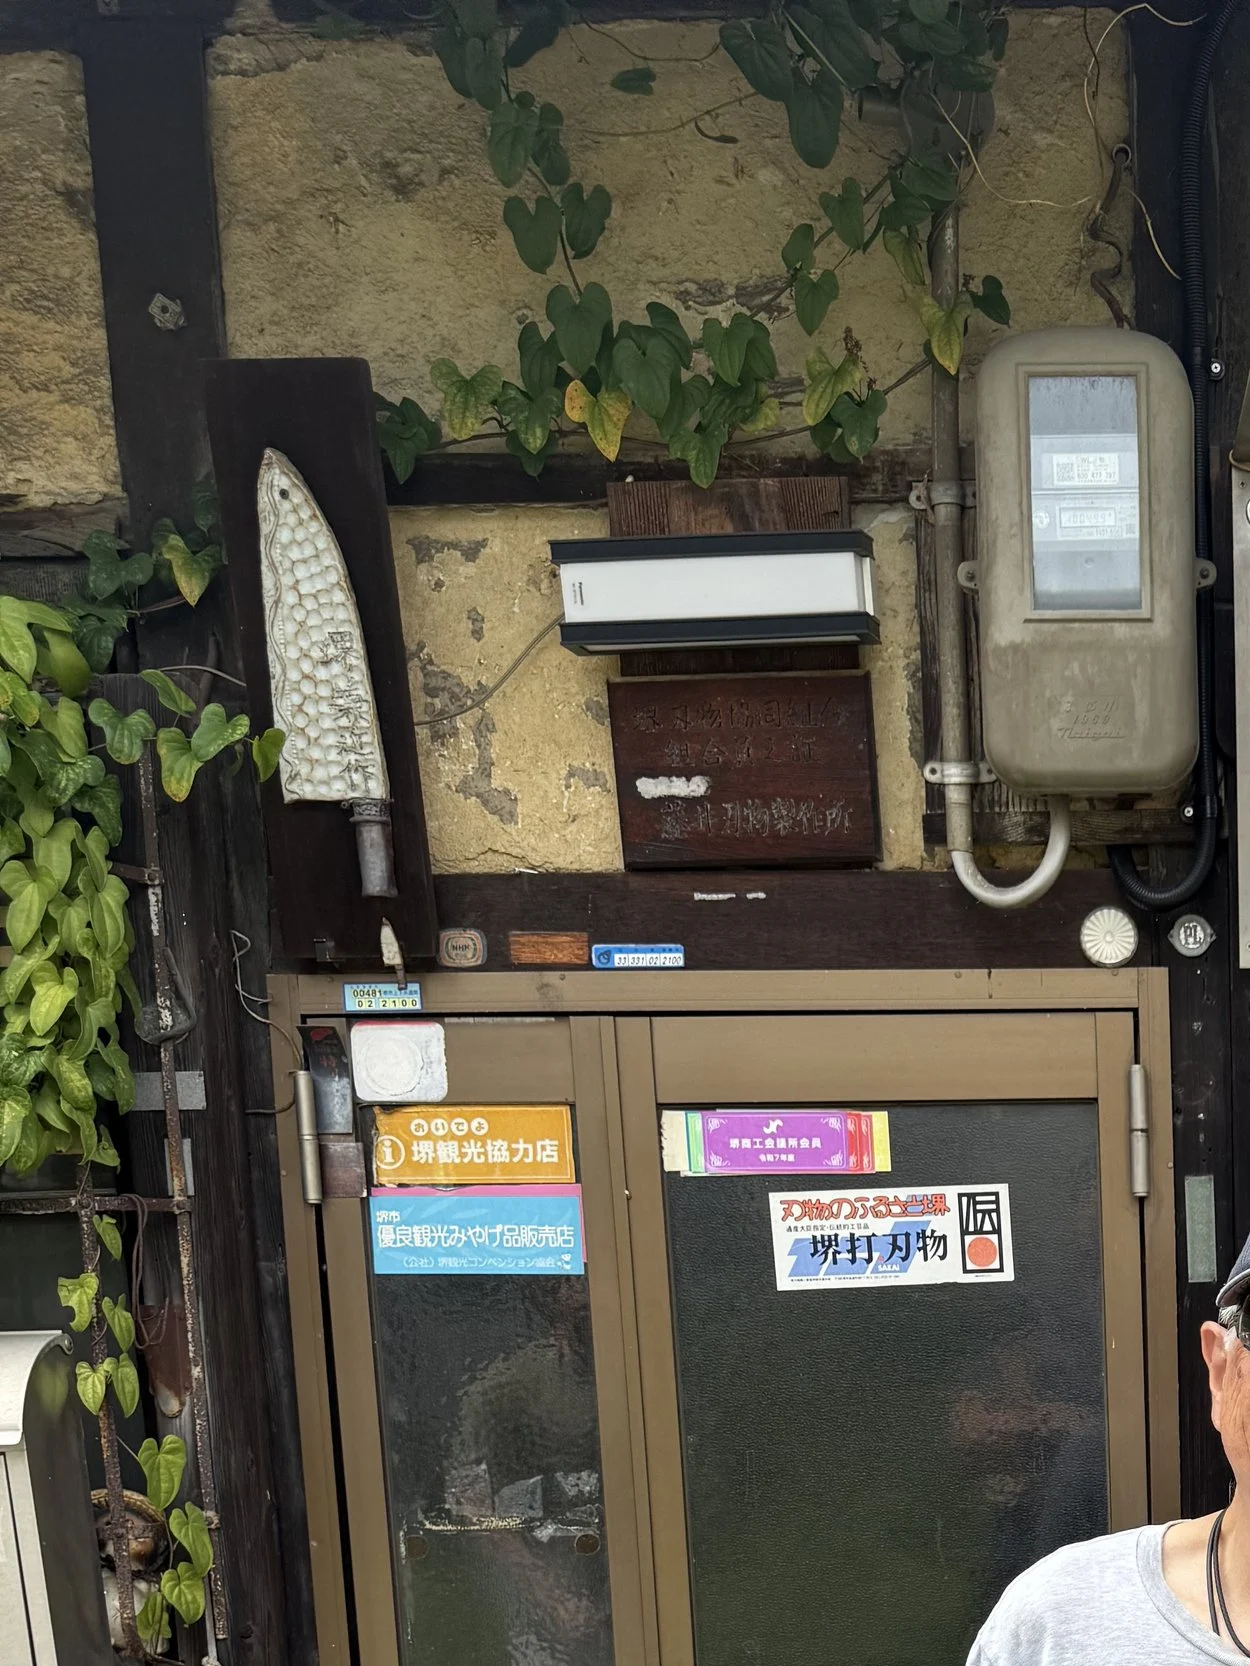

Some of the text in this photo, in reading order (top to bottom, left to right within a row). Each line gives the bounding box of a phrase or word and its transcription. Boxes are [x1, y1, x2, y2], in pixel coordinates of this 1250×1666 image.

[452, 943, 471, 952] NHK
[662, 956, 682, 966] 2100
[381, 999, 417, 1008] 2100
[410, 1118, 489, 1136] おいでよ
[729, 1138, 821, 1149] 堺商工会議所会員
[411, 1139, 559, 1164] 堺観光協力店
[780, 1193, 951, 1222] 刃物のふるさと堺
[376, 1211, 400, 1223] 堺市
[377, 1224, 575, 1248] 優良観光みやげ品販売店
[809, 1228, 949, 1266] 堺打刃物
[877, 1264, 900, 1272] SAKAI
